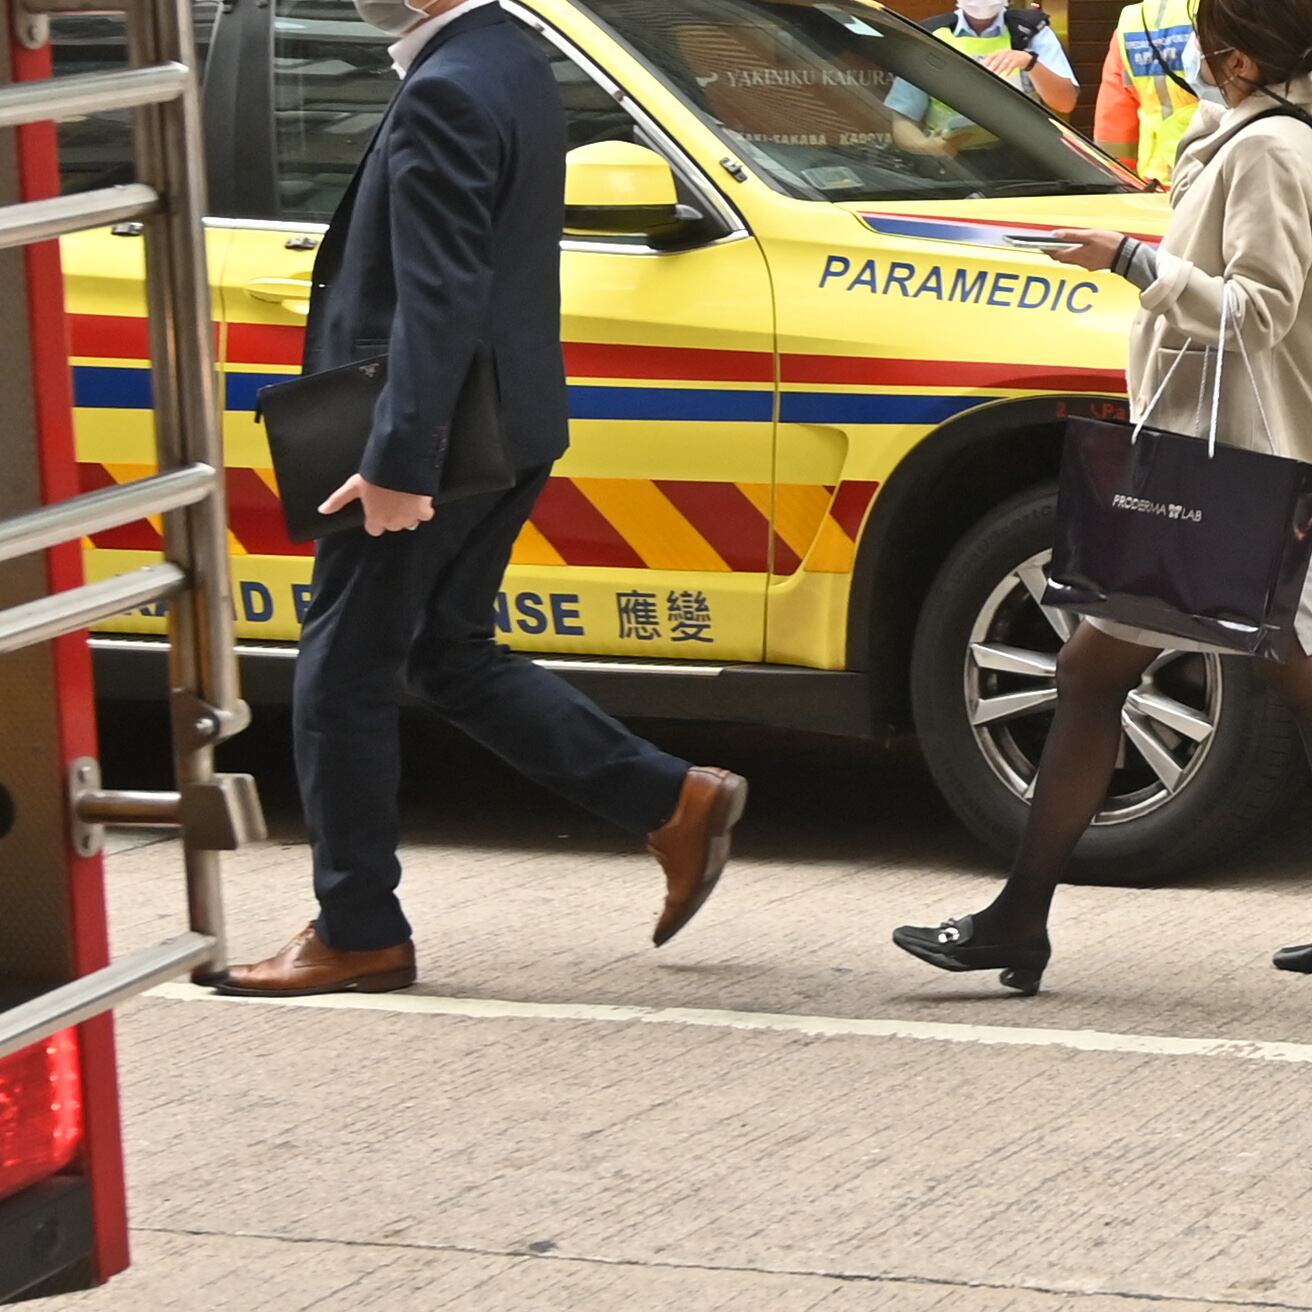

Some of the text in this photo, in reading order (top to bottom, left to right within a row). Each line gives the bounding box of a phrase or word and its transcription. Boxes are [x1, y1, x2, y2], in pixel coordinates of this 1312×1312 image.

[818, 255, 1099, 314] PARAMEDIC
[1112, 494, 1202, 522] PRODERMA LAB
[614, 589, 714, 645] 應變
